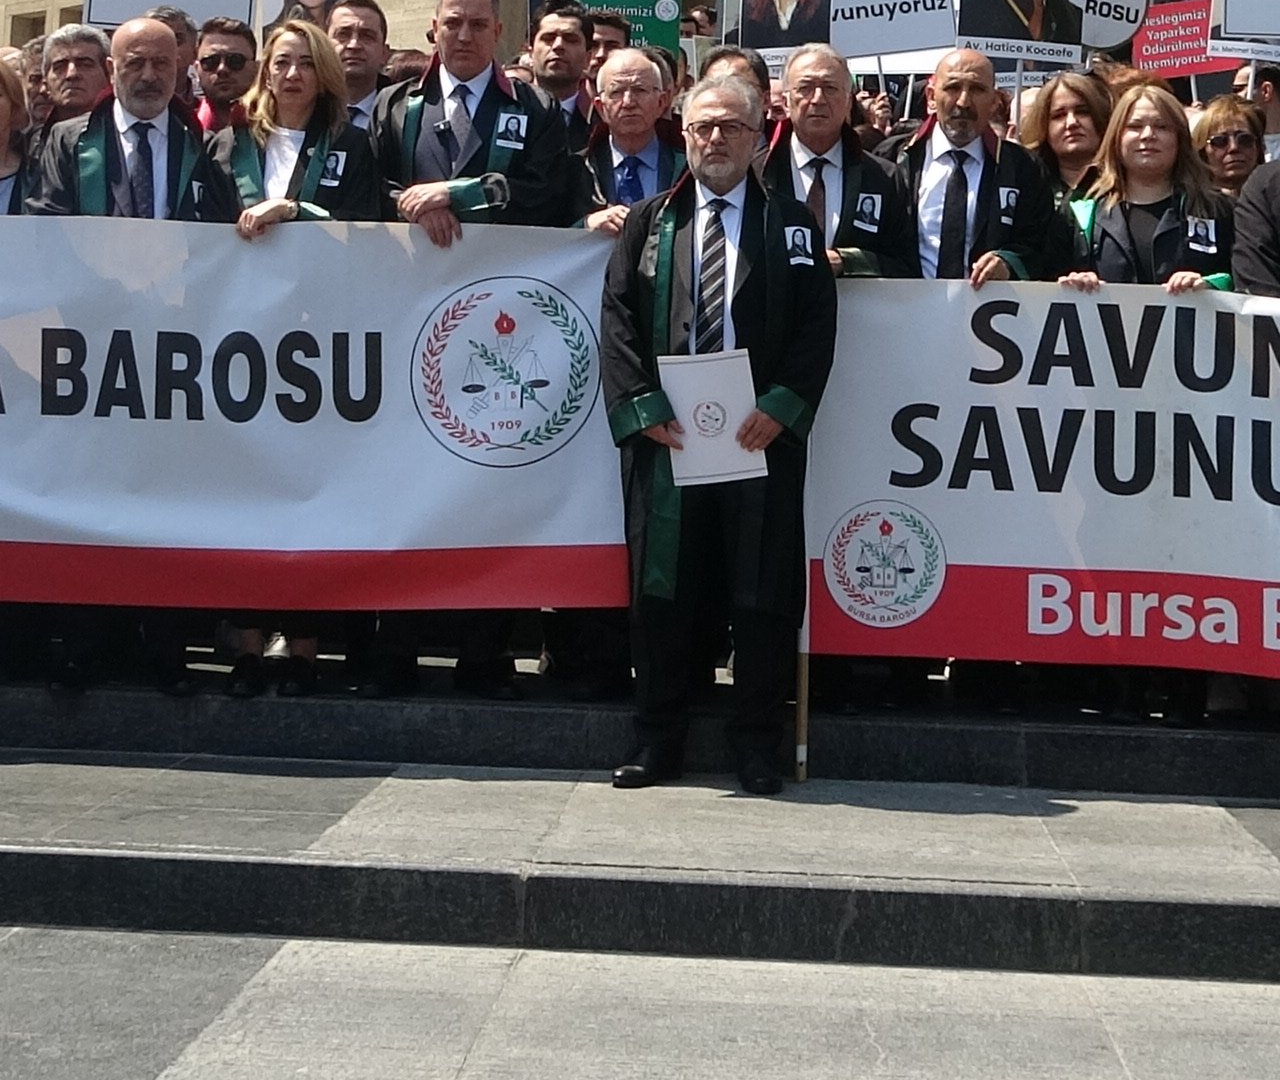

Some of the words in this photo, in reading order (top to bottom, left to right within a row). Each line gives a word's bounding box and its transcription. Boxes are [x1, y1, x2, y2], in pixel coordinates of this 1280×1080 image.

[1146, 26, 1200, 41] Yaparken
[985, 41, 1023, 53] Hatice
[40, 327, 382, 423] BAROSU
[491, 420, 522, 431] 1909
[847, 604, 877, 622] BURSA
[879, 606, 918, 623] BAROSU
[1027, 573, 1239, 644] Bursa
